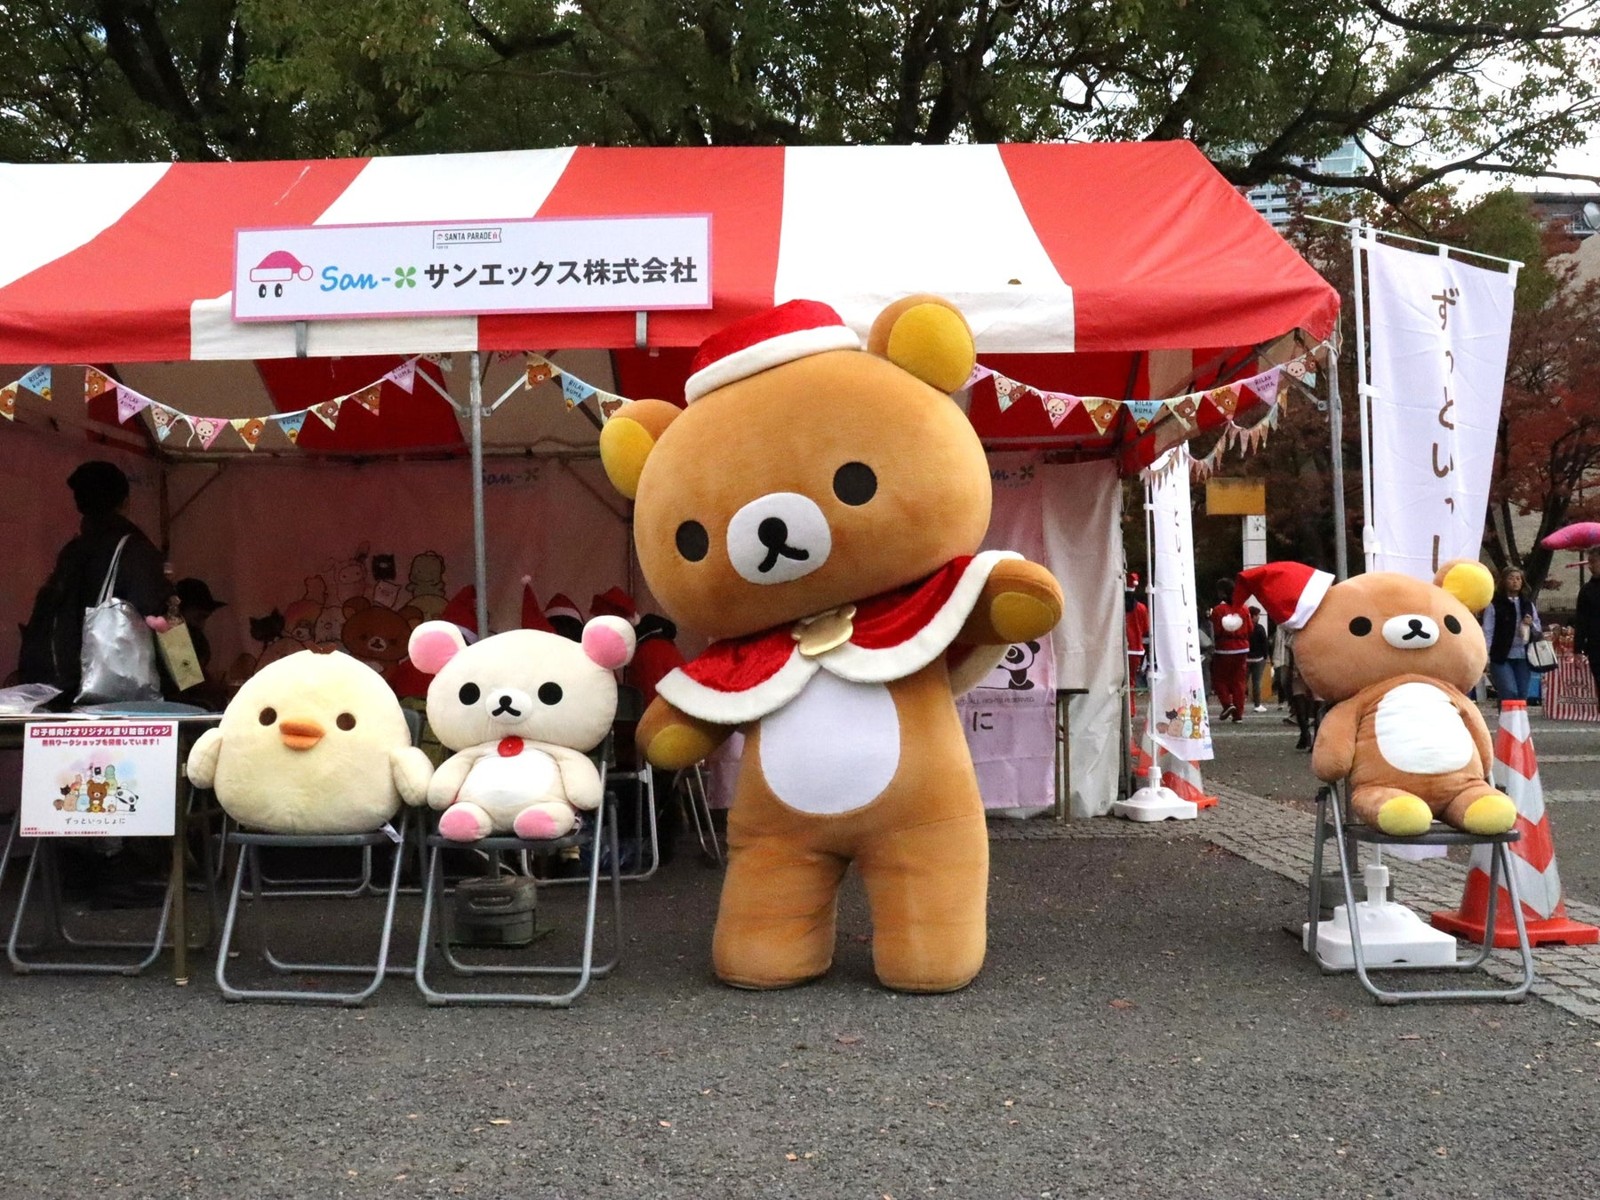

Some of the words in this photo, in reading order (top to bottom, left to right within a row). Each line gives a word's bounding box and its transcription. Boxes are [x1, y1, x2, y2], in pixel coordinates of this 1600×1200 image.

[445, 232, 466, 241] SANTA
[467, 231, 492, 240] PARADE
[424, 256, 699, 290] サンエックス株式会社
[65, 817, 127, 825] ずっといっしょに
